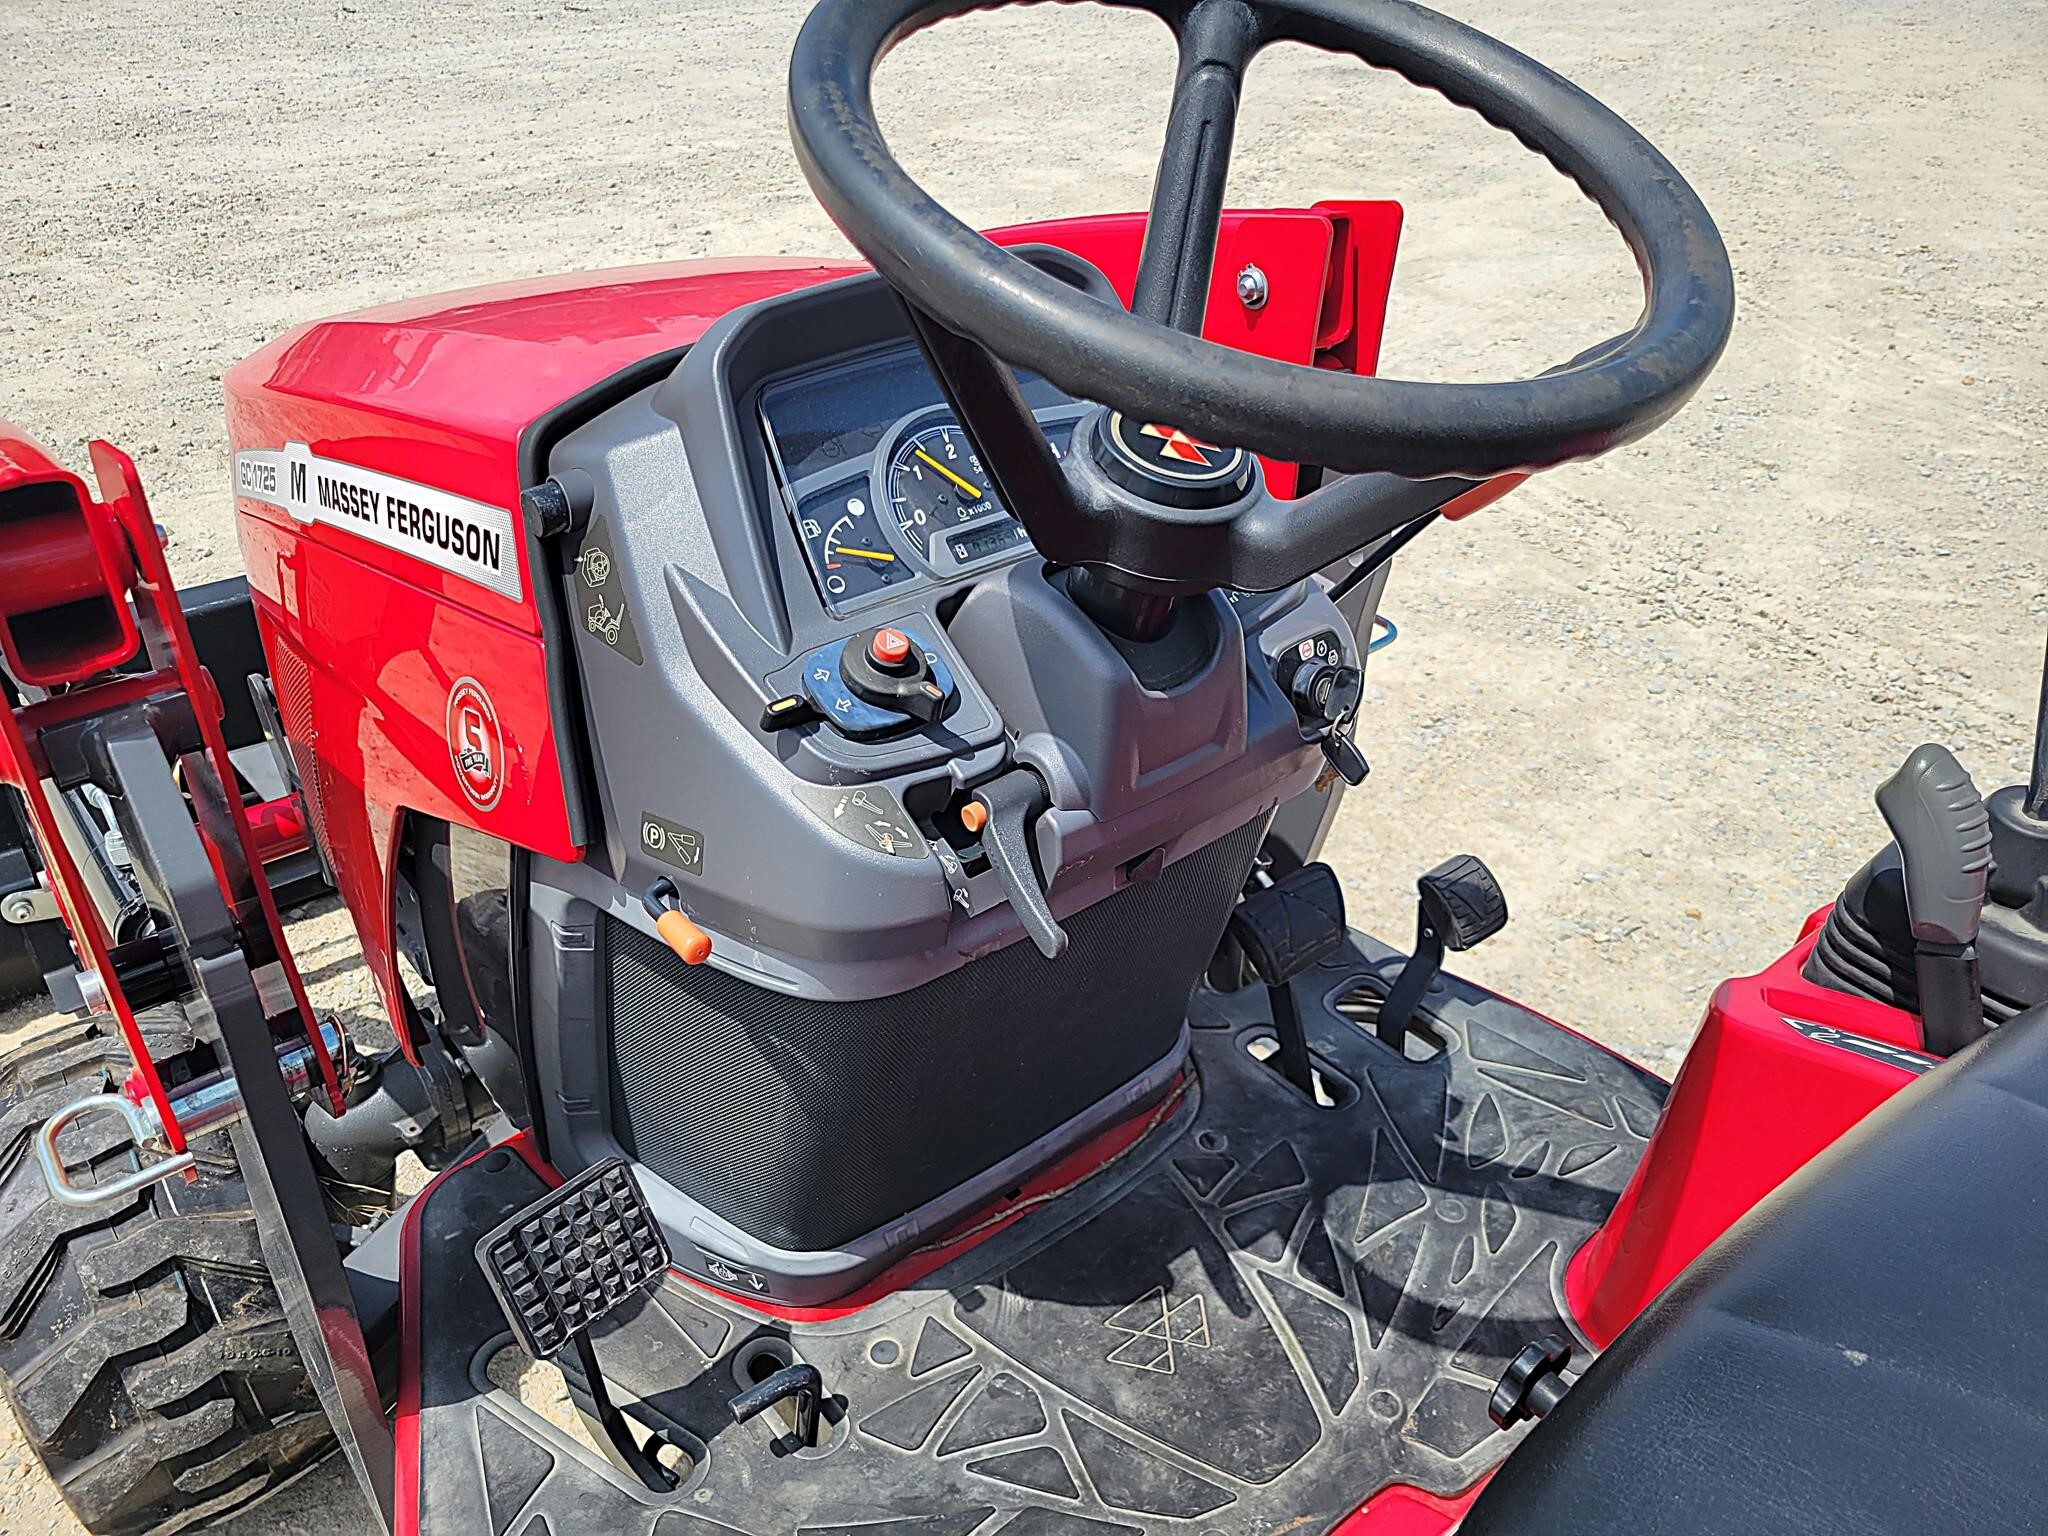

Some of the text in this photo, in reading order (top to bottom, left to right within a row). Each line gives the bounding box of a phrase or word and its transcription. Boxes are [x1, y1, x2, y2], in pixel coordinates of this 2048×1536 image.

[945, 444, 957, 460] 2
[912, 465, 922, 480] 1
[290, 461, 306, 503] M
[317, 475, 380, 525] MASSEY
[386, 496, 500, 571] FERGUSON
[968, 502, 992, 516] x1000
